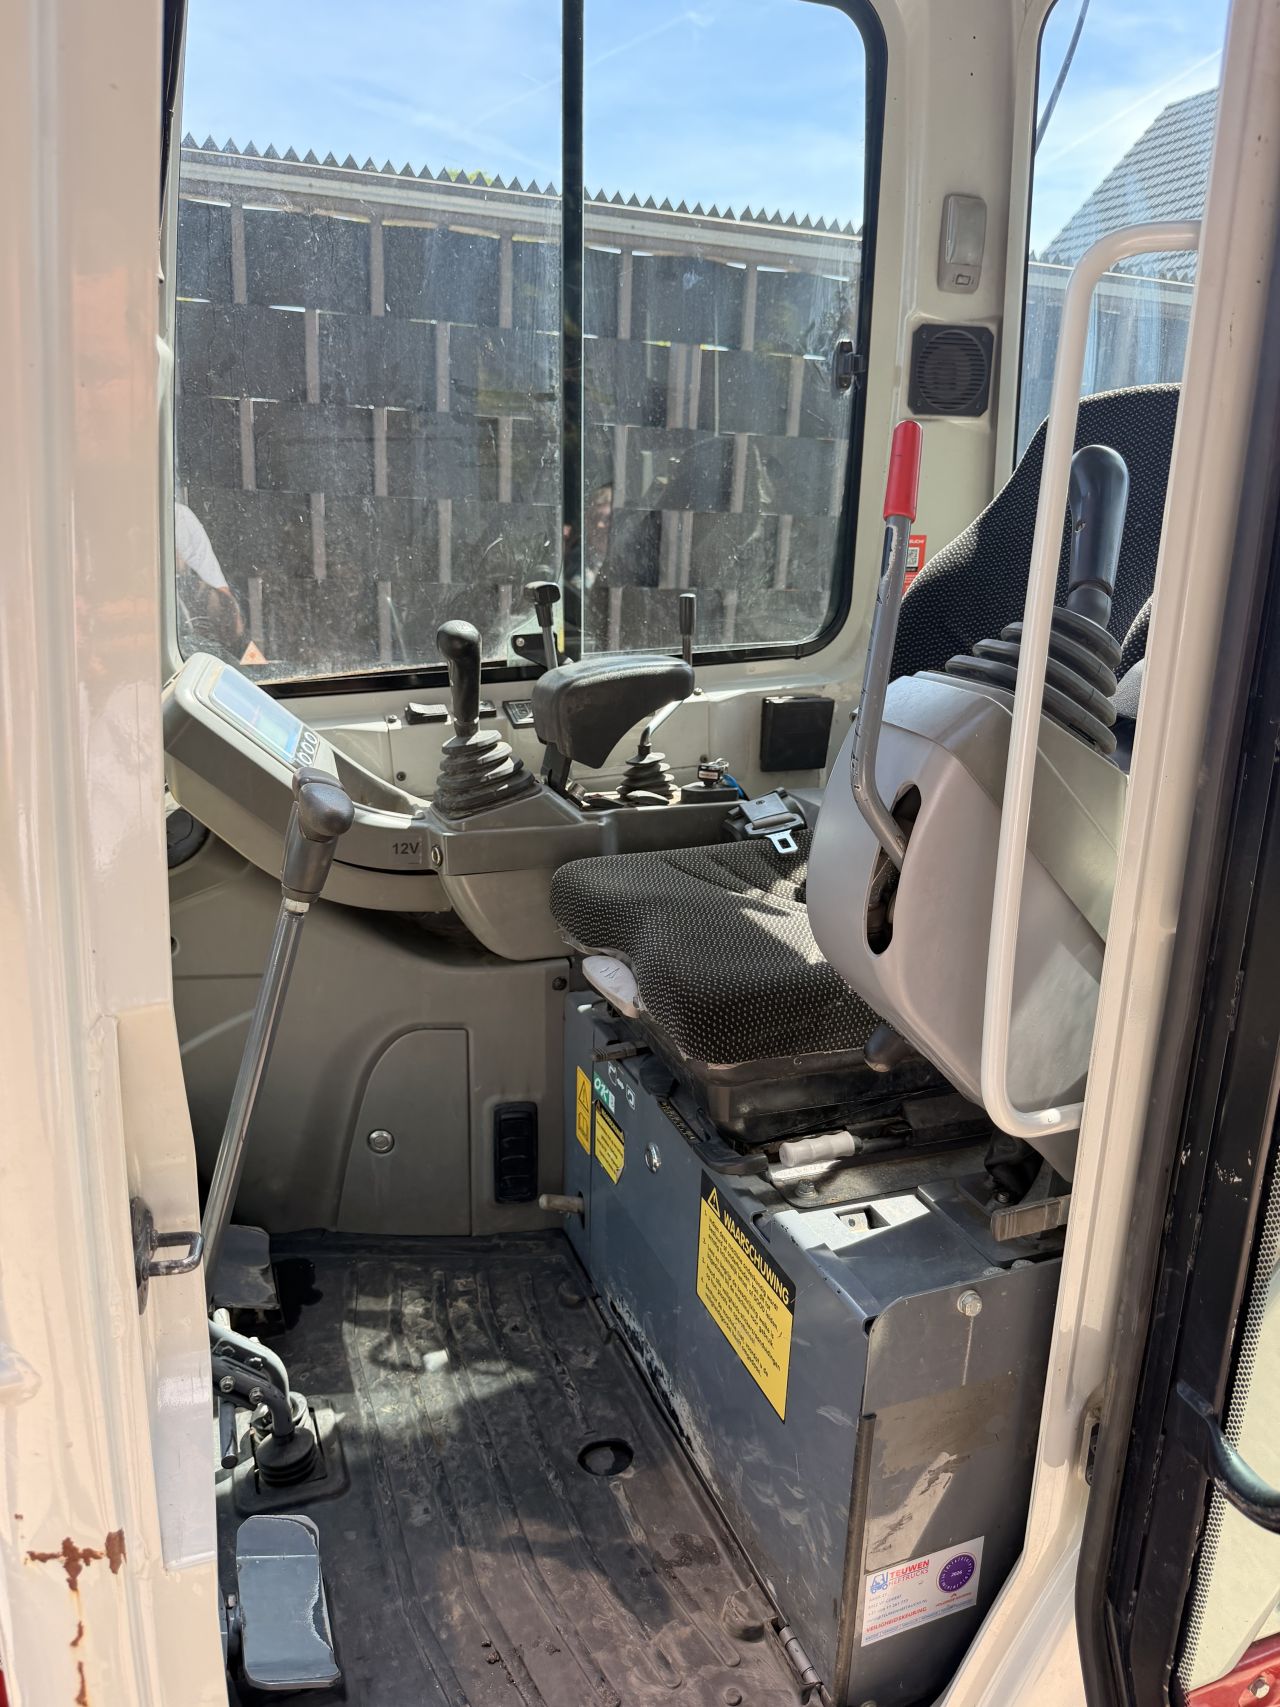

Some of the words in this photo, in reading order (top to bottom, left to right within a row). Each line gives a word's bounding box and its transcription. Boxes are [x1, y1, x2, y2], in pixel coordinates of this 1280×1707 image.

[392, 842, 420, 855] 12V
[723, 1208, 789, 1307] WAARSCHUWING
[889, 1559, 930, 1578] TEUWEN
